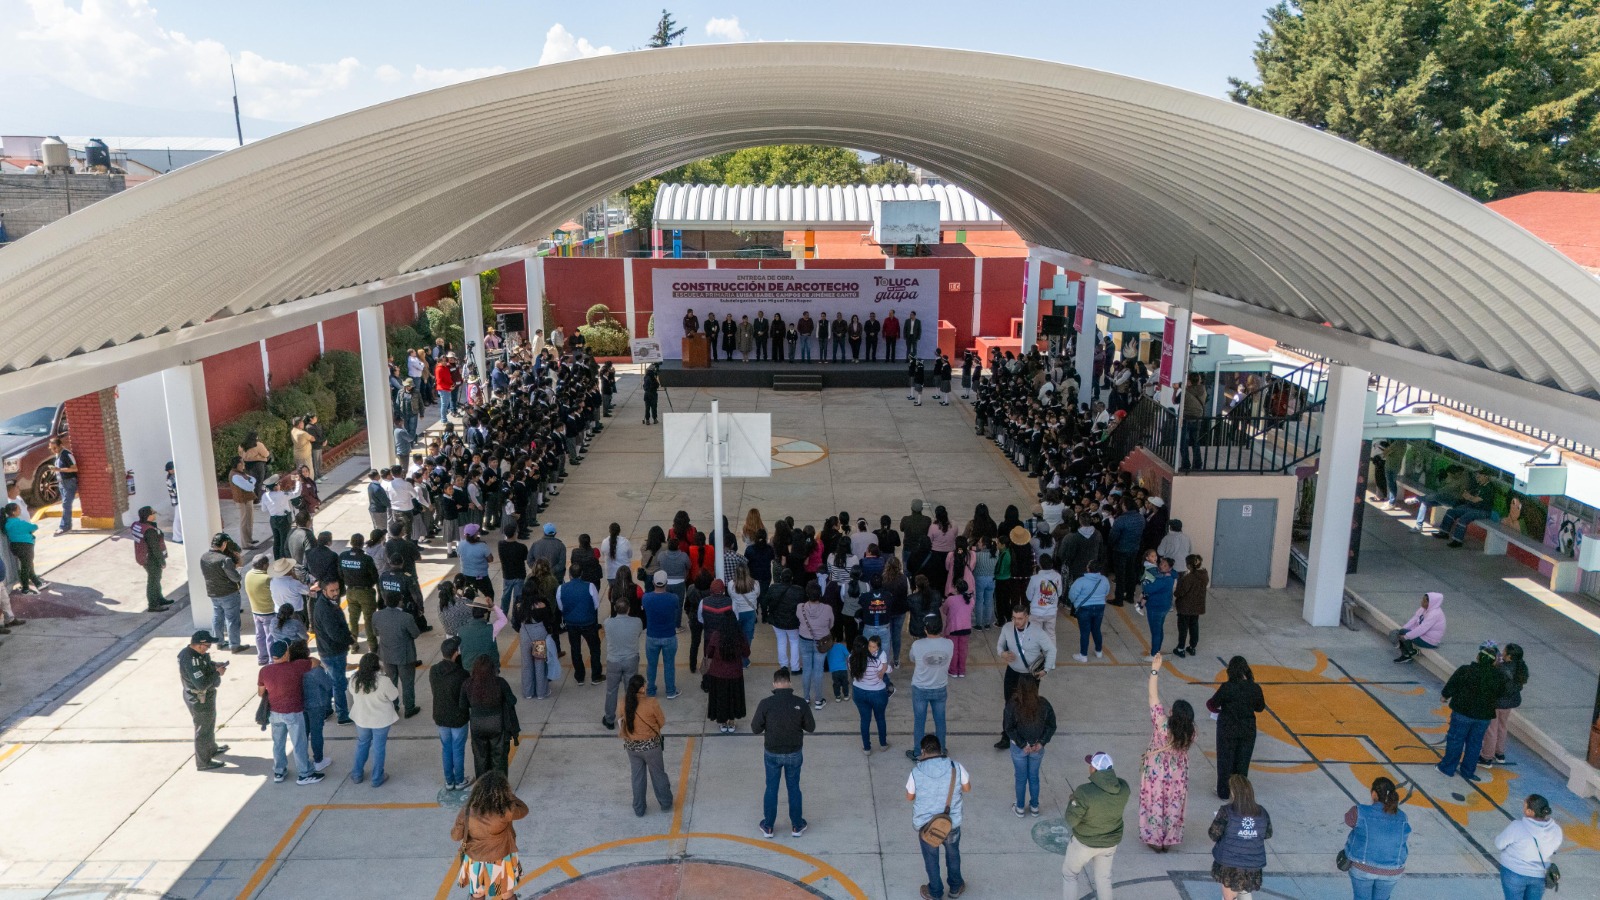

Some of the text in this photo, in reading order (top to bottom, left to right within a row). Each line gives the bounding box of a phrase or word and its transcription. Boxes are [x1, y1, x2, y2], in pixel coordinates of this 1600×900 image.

[672, 281, 860, 291] CONSTRUCCIÓN DE ARCOTECHO
[874, 276, 919, 286] TOLUCA
[874, 290, 919, 303] guapa
